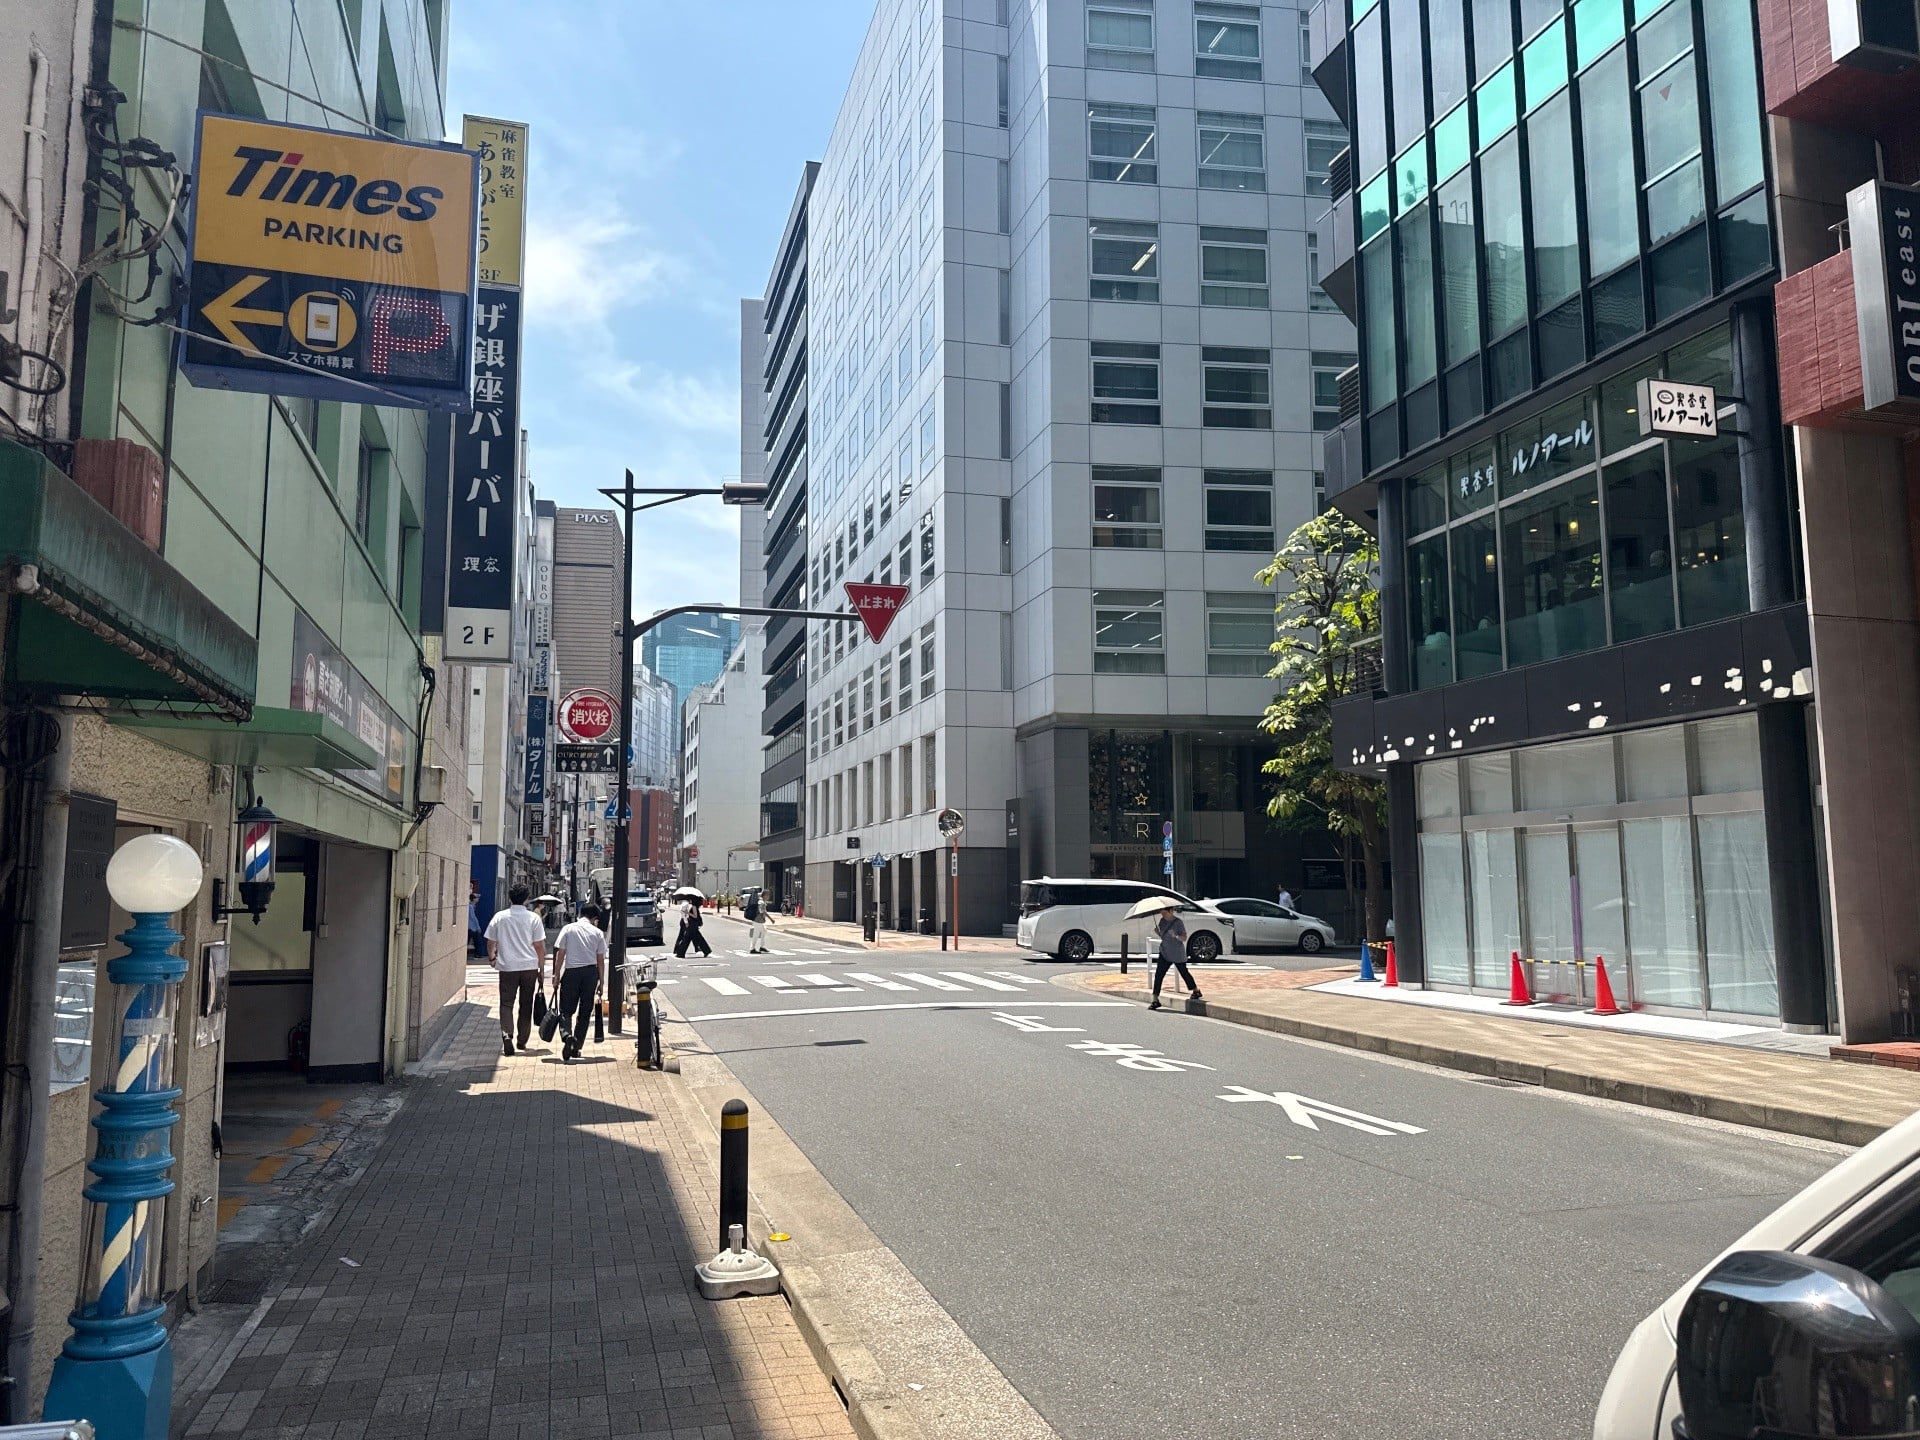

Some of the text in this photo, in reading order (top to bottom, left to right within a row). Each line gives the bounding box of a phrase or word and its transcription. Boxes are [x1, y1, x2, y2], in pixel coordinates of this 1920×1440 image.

[499, 129, 517, 199] 麻雀教室
[226, 145, 444, 222] Times
[264, 218, 404, 255] PARKING
[1894, 207, 1916, 286] east
[480, 268, 501, 281] 3F
[372, 294, 450, 375] P
[287, 351, 355, 369] スマホ精算
[467, 303, 507, 536] ザ銀座バーバー
[1653, 407, 1714, 428] ルノアール
[1512, 419, 1594, 476] ルノアール
[575, 513, 609, 524] PIAS
[462, 556, 500, 573] 理容
[858, 595, 897, 609] 止まれ
[571, 708, 610, 726] 消火栓
[1136, 822, 1149, 838] R
